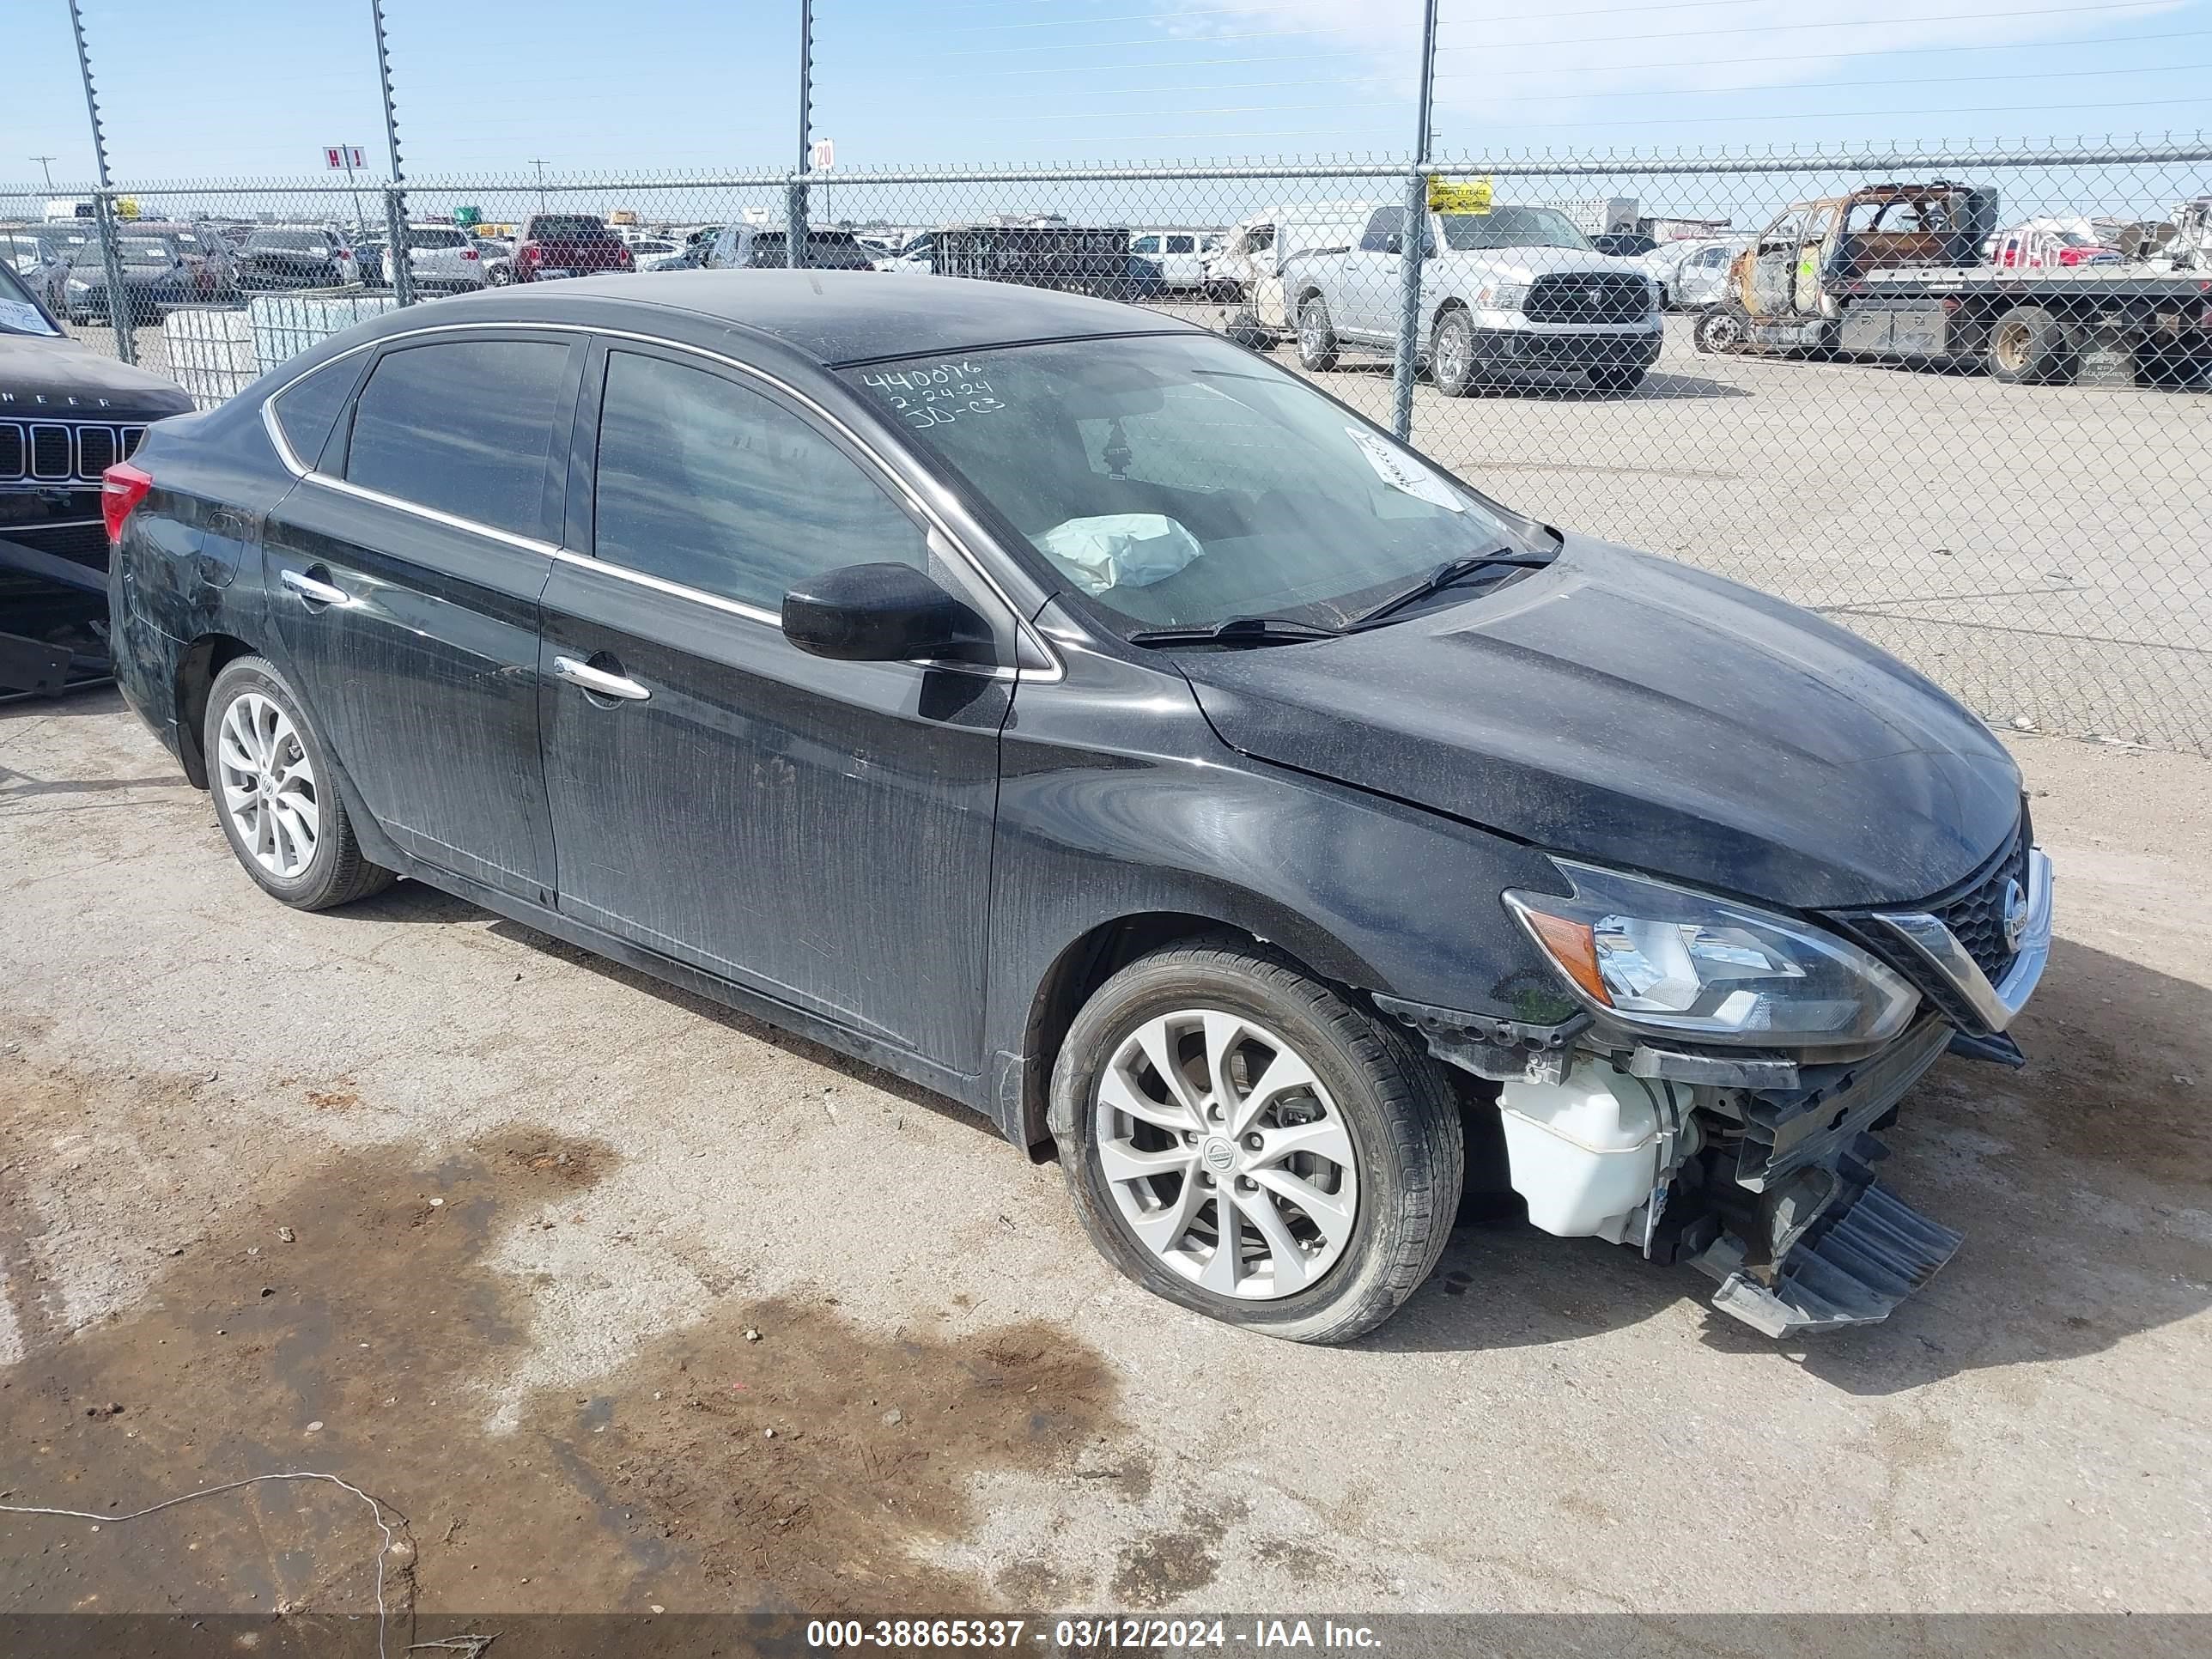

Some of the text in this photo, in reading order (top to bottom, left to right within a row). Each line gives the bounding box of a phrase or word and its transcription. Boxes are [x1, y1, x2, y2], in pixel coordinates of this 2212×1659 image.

[328, 149, 340, 167] H
[817, 145, 831, 165] 20
[862, 362, 982, 392] 440076
[2, 392, 111, 407] NEER
